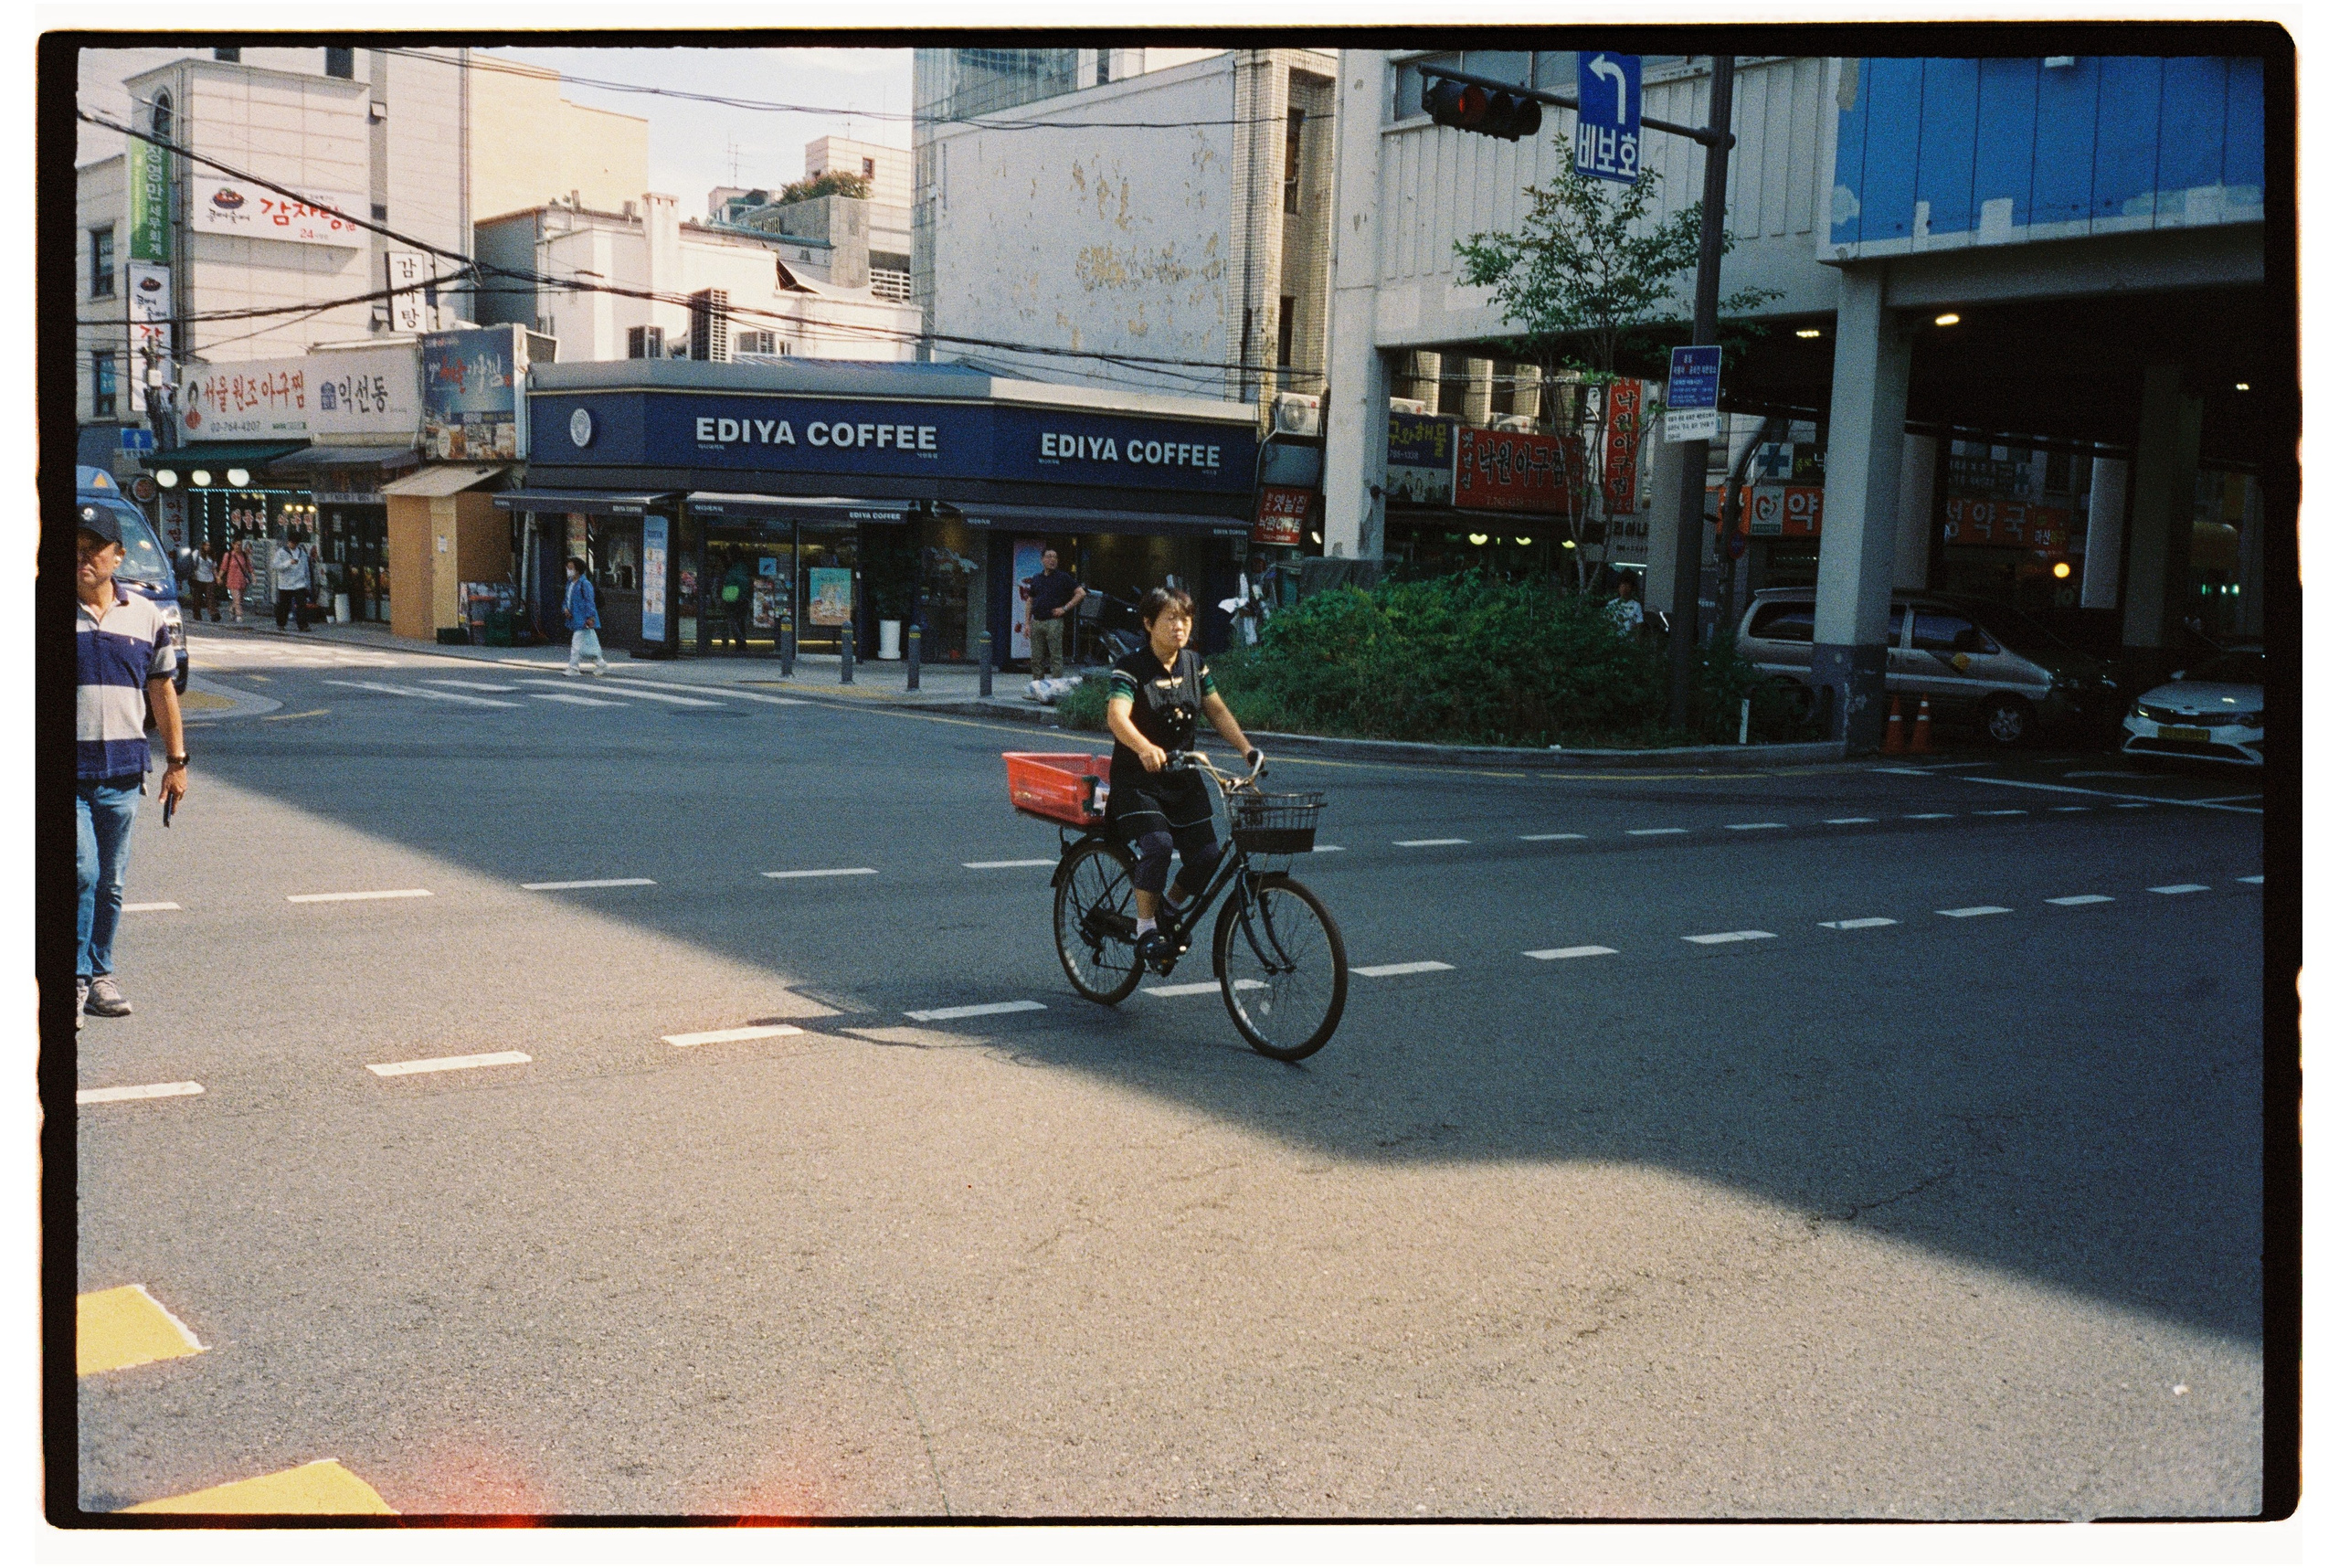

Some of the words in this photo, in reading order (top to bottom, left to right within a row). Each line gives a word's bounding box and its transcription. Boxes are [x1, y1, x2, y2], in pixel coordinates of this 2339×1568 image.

[1577, 122, 1636, 176] 비보호
[338, 375, 388, 415] 익선동
[696, 418, 796, 445] EDIYA
[807, 421, 937, 450] COFFEE
[1041, 433, 1119, 461] EDIYA
[1127, 440, 1221, 468] COFFEE
[849, 511, 870, 519] EDIYA
[873, 513, 901, 521] COFFEE
[1787, 492, 1819, 532] 약
